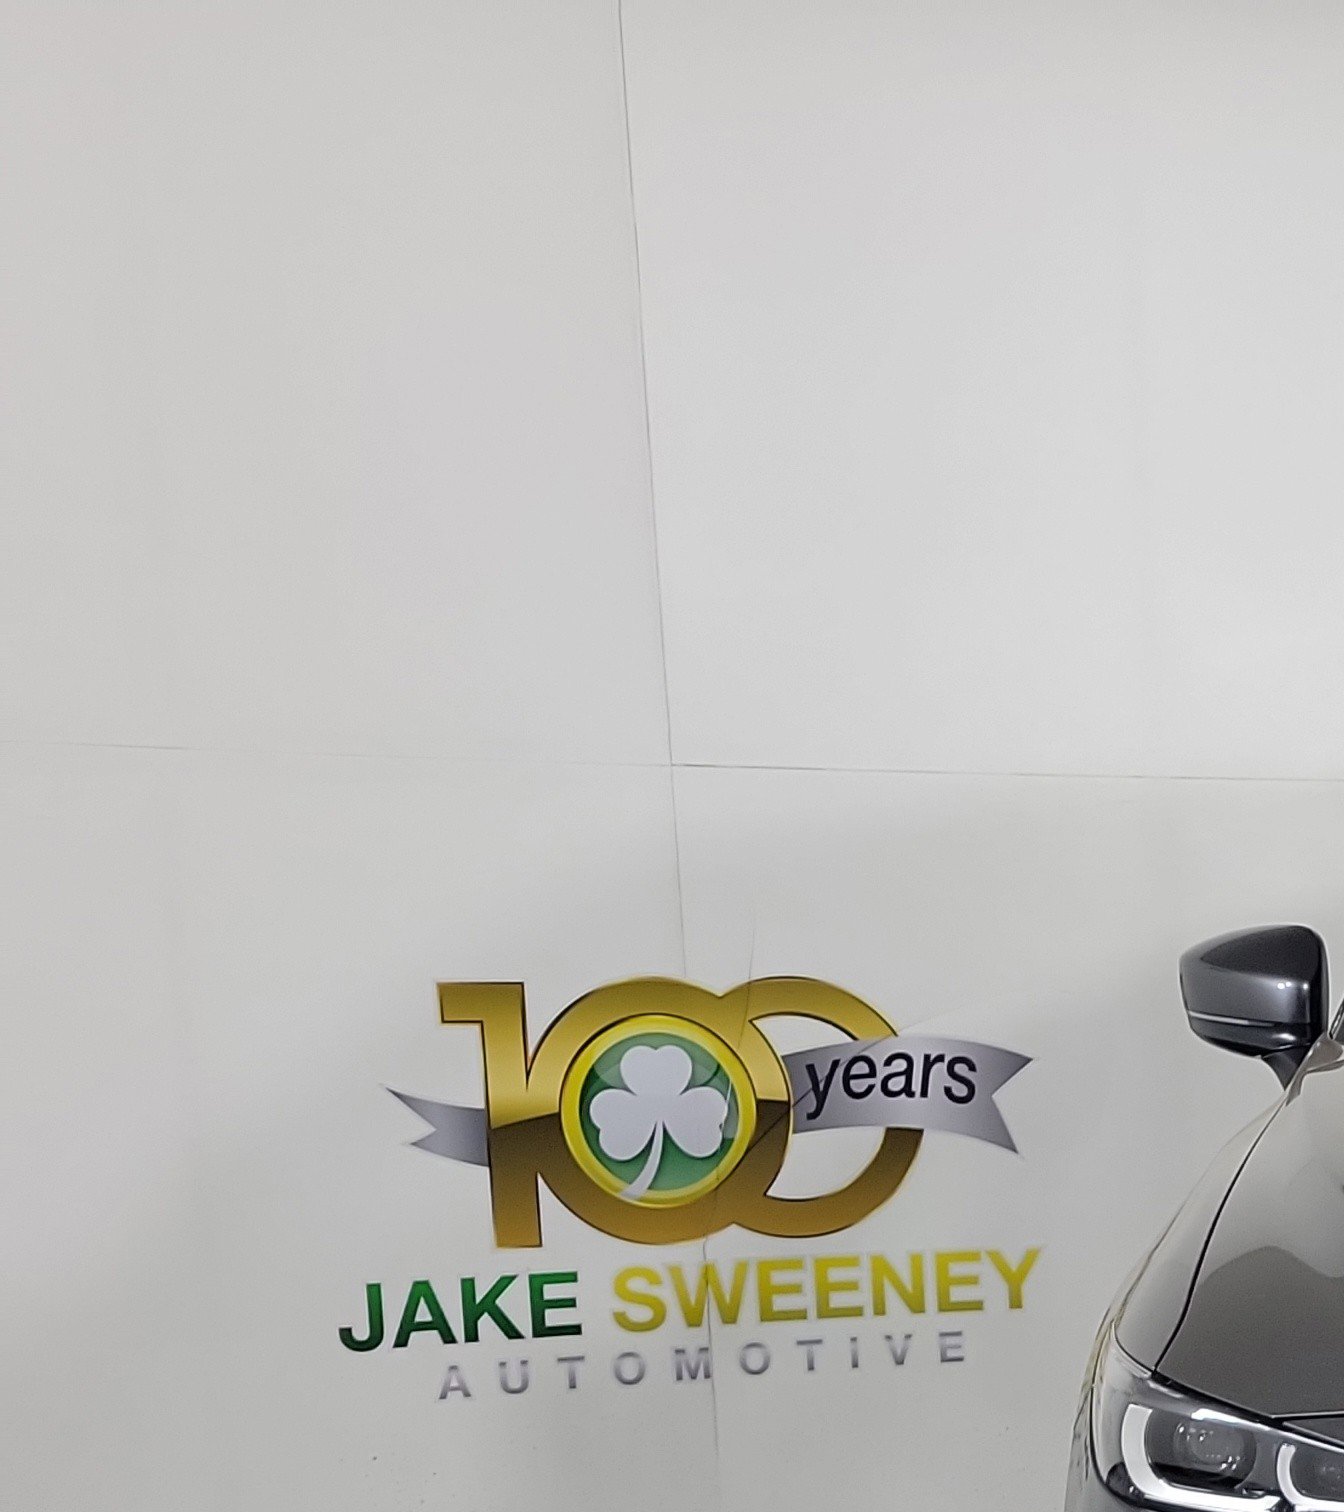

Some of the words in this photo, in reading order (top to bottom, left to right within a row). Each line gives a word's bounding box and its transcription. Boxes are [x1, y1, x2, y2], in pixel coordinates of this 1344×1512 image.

[436, 975, 925, 1249] 100
[803, 1051, 979, 1120] years
[338, 1270, 584, 1353] JAKE
[611, 1246, 1044, 1333] SWEENEY
[437, 1330, 966, 1400] AUTOMOTIVE
